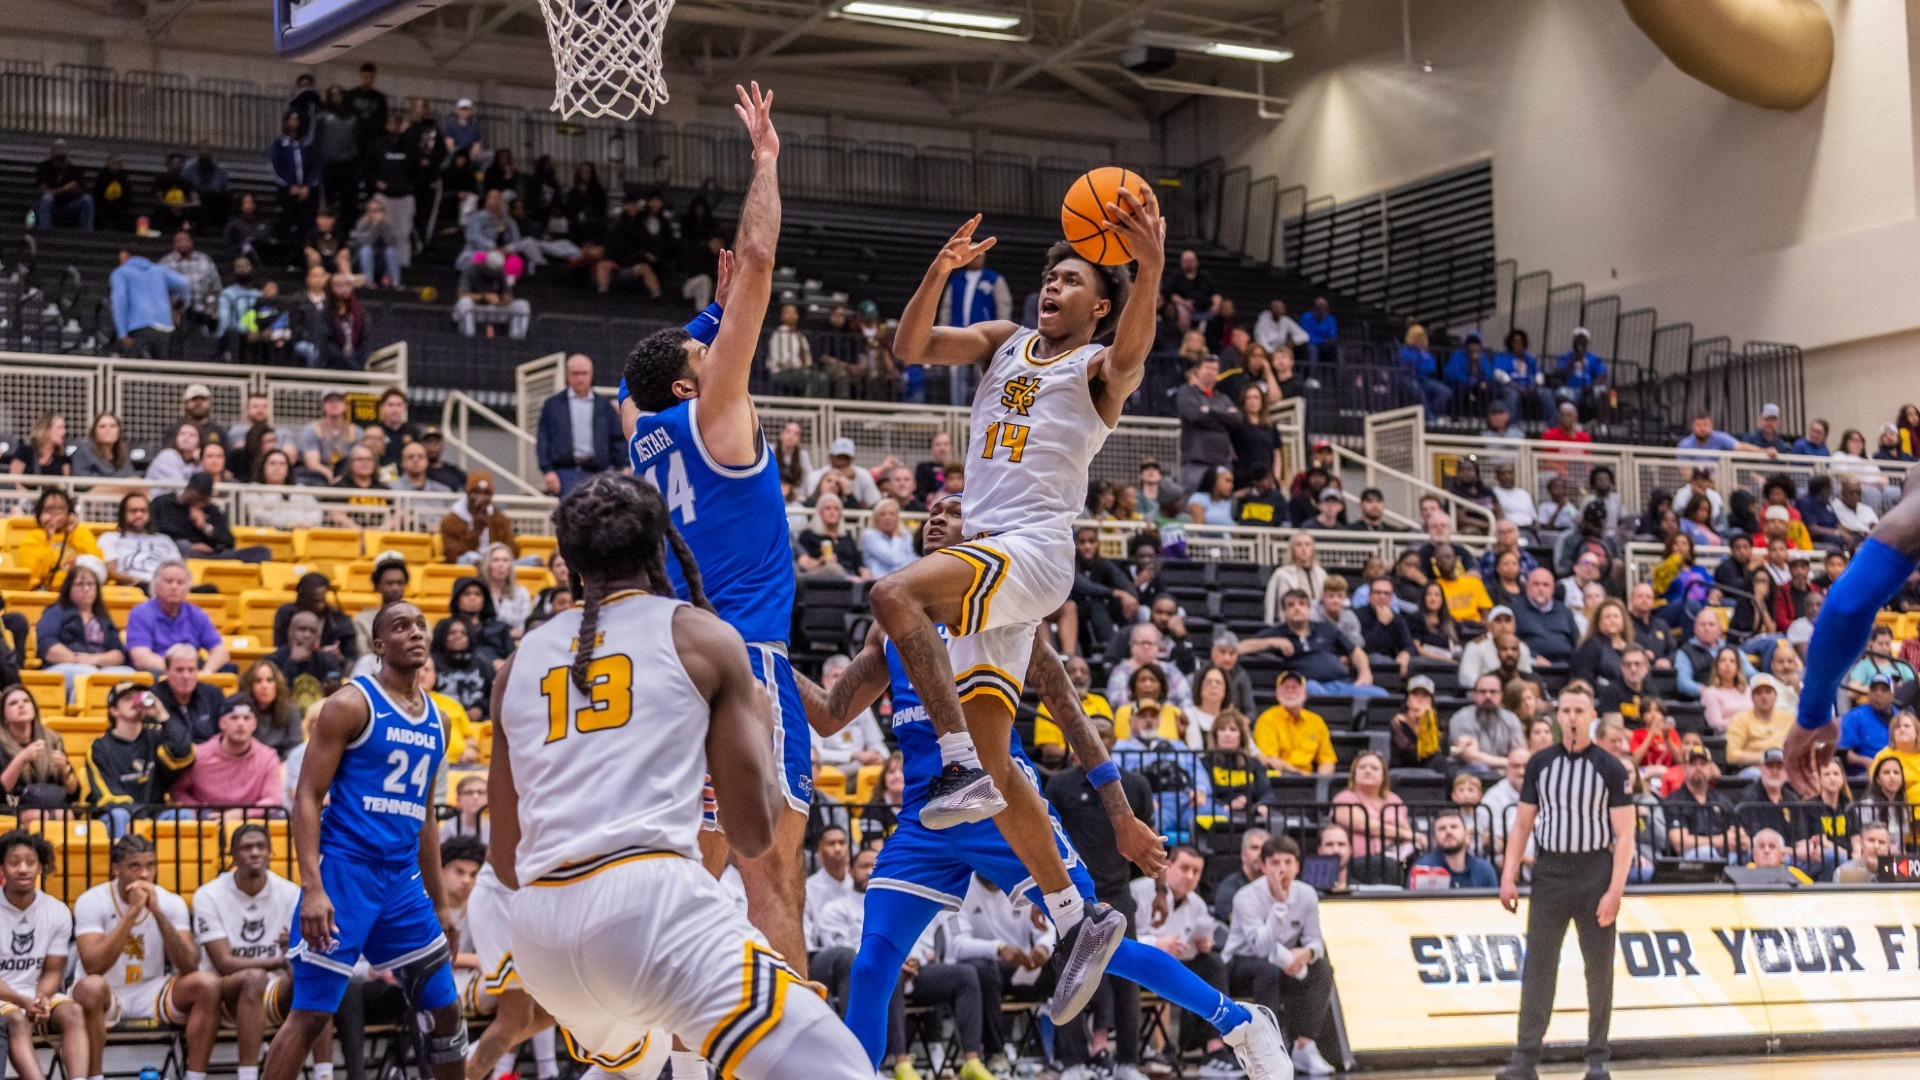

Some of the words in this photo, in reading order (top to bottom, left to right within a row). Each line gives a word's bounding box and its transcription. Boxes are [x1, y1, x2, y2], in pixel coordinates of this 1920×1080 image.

[981, 421, 1030, 463] 14
[540, 653, 633, 746] 13
[386, 726, 436, 750] MIDDLE
[383, 749, 431, 798] 24
[1410, 935, 1527, 984] SHO
[1711, 927, 1866, 976] YOUR
